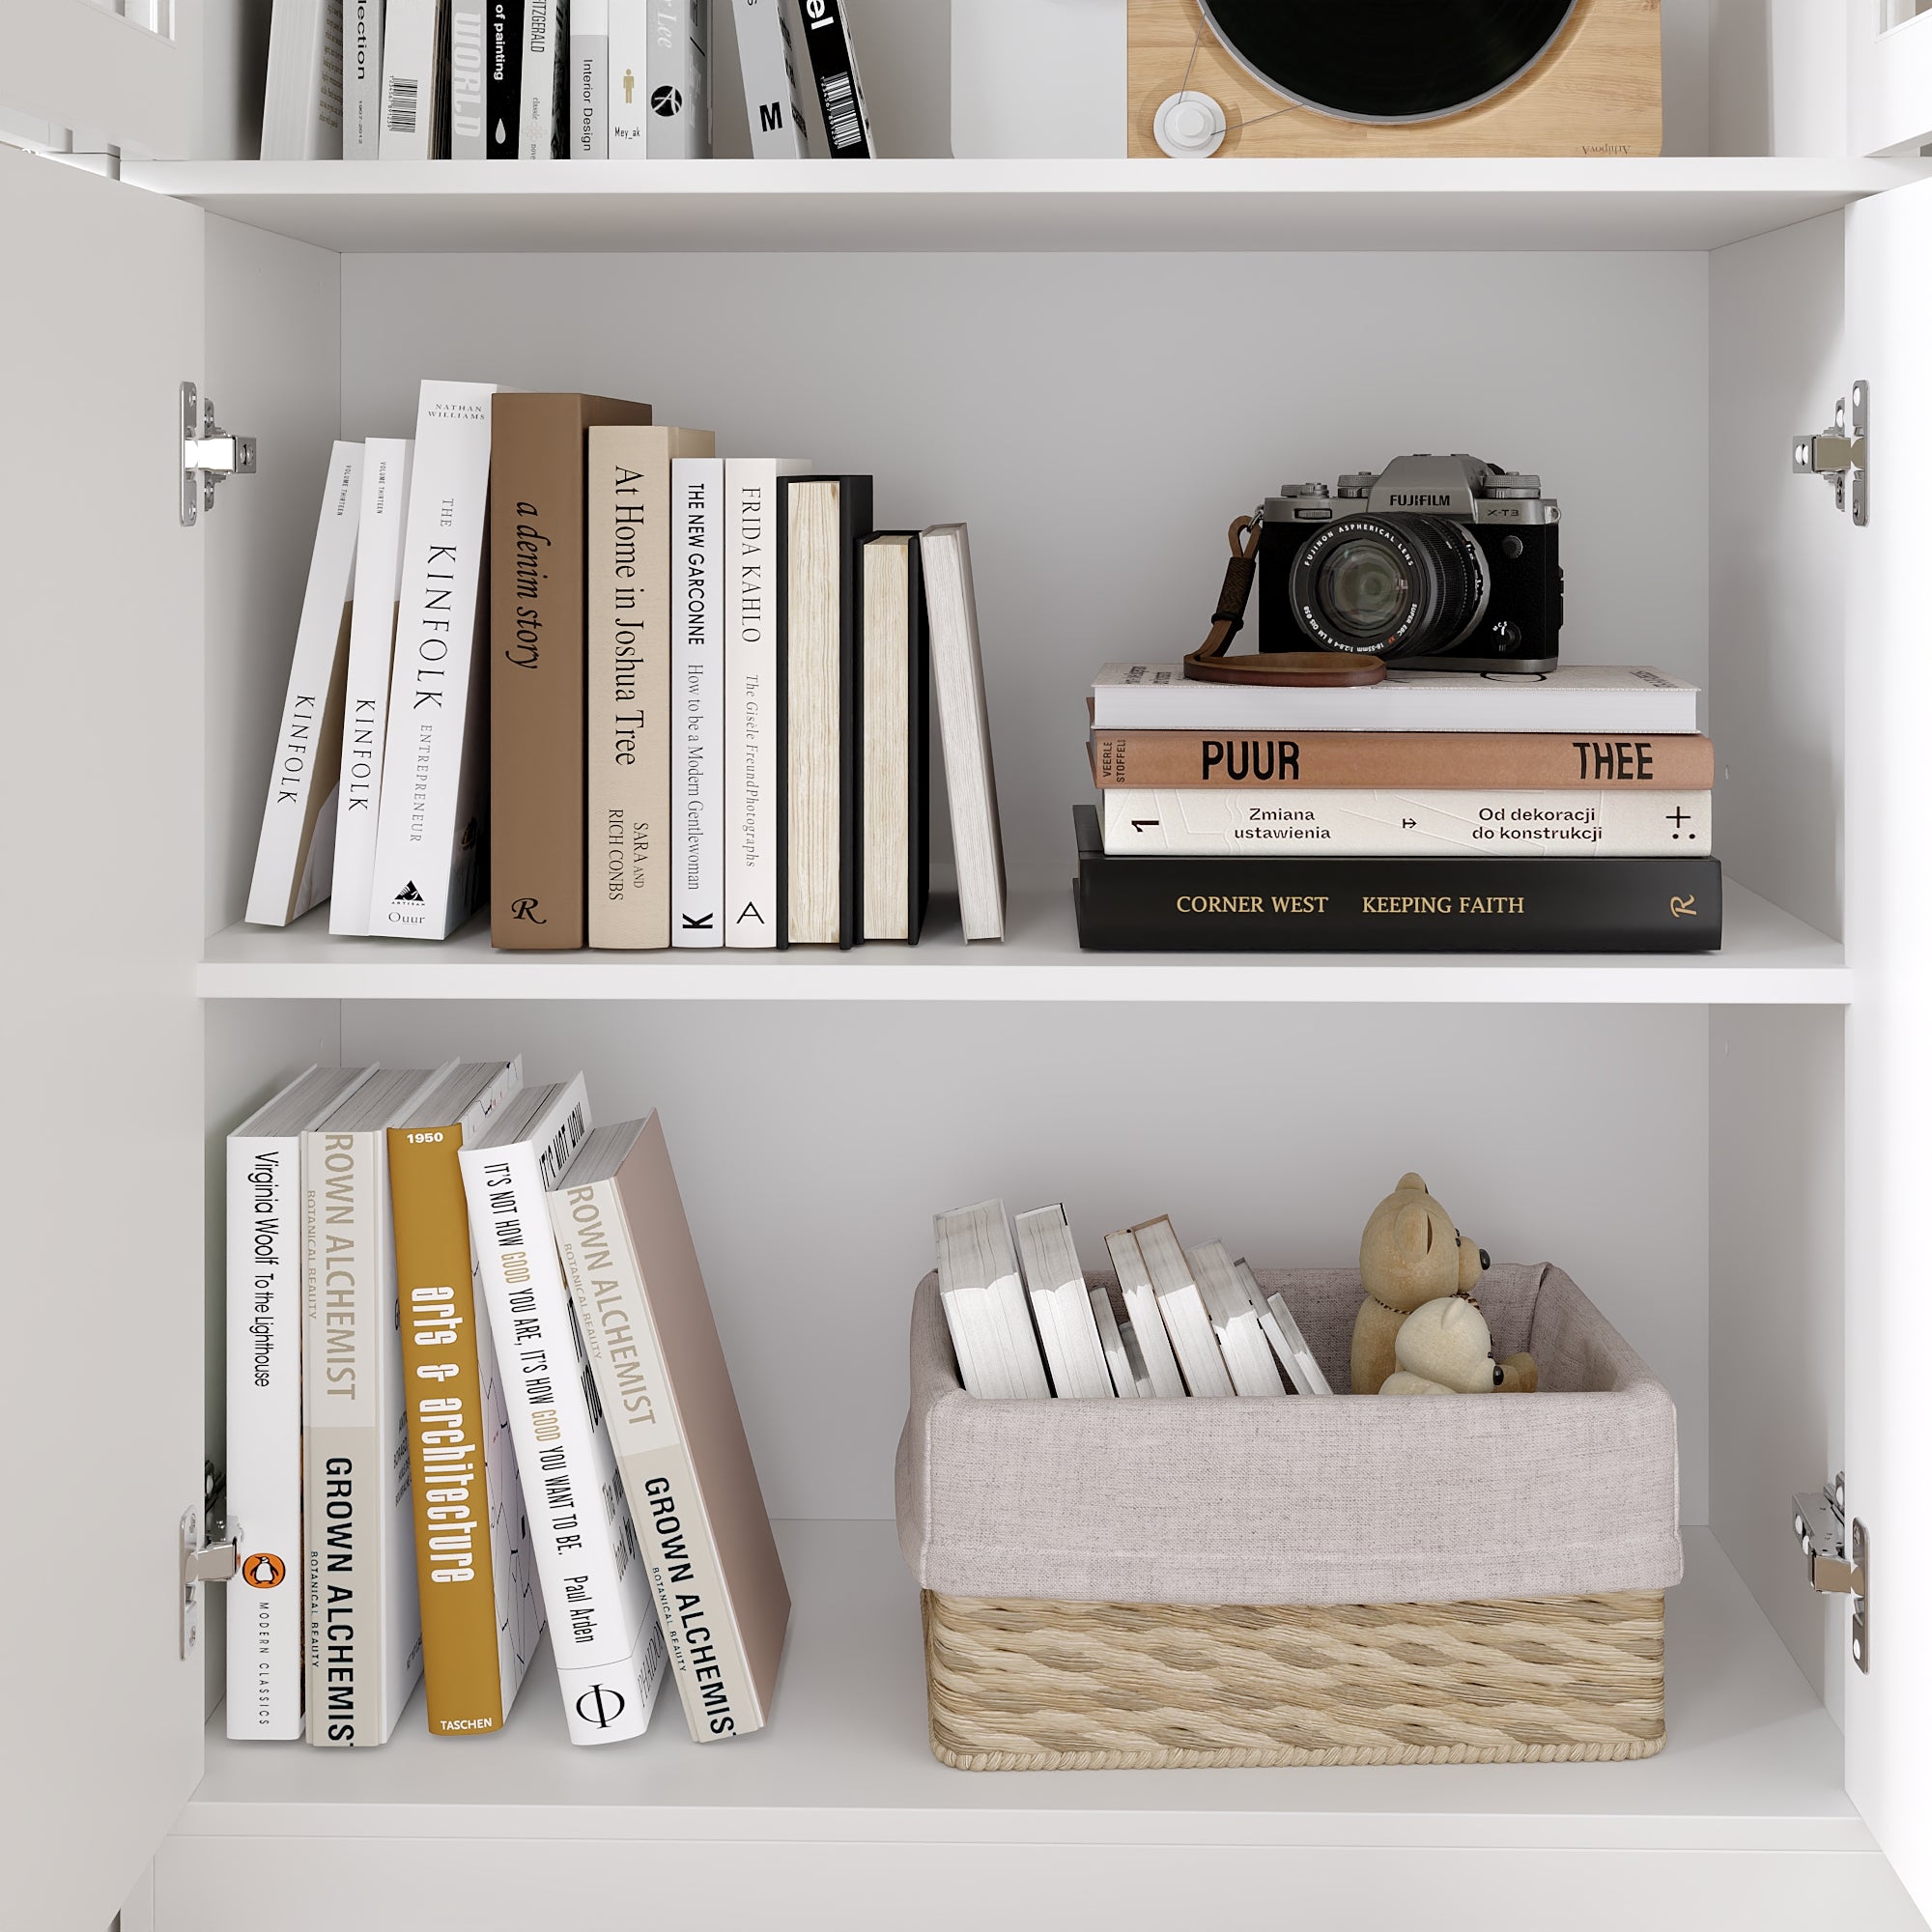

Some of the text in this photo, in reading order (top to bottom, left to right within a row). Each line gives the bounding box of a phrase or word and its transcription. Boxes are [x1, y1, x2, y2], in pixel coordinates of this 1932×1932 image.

[494, 4, 505, 81] of painting
[454, 13, 481, 137] WORLD
[582, 59, 593, 152] Interior Design
[759, 101, 782, 132] M
[428, 411, 485, 420] WILLIAMS
[336, 465, 352, 516] VOLUME THIRTEEN
[376, 486, 384, 514] THIRTEEN
[688, 483, 705, 509] THE
[1389, 495, 1451, 506] FUJIFILM
[688, 514, 705, 548] NEW
[742, 487, 761, 556] FRIDA
[1304, 524, 1414, 567] FUJINON ASPHERICAL LENS
[506, 501, 552, 669] a denim story
[688, 553, 705, 645] GARCONNE
[742, 565, 761, 642] KAHLO
[615, 466, 644, 766] At Home in Joshua Tree
[410, 497, 457, 843] THE KINFOLK ENTREPRENEUR
[688, 665, 703, 696] How
[747, 674, 759, 696] The
[688, 699, 699, 712] to
[688, 716, 703, 730] be
[746, 701, 758, 740] Gisèle
[277, 695, 316, 805] KINFOLK
[348, 698, 376, 811] KINFOLK
[688, 747, 703, 796] Modern
[1202, 740, 1654, 781] PUUR THEE
[1234, 826, 1331, 839] ustawienia
[1249, 808, 1316, 822] Zmiana
[1472, 826, 1603, 842] do konstrukcji
[1478, 808, 1596, 825] Od dekoracji
[609, 809, 624, 901] RICH CONBS
[634, 822, 649, 889] SARA AND
[688, 800, 704, 890] Gentlewoman
[511, 897, 548, 924] R
[682, 912, 714, 929] K
[736, 901, 765, 924] A
[1176, 895, 1525, 914] CORNER WEST KEEPING FAITH
[1670, 894, 1697, 919] R
[406, 1132, 444, 1144] 1950
[247, 1151, 279, 1387] Virginia Woolf To the Lighthouse
[325, 1134, 355, 1401] ROWN ALCHEMIST
[411, 1286, 464, 1346] arts
[567, 1184, 612, 1271] ROWN
[591, 1279, 656, 1425] ALCHEMIST
[484, 1162, 599, 1644] IT'S NOT HOW GOOD YOU ARE, IT'S HOW GOOD YOU WANT TO BE. Paul Arden
[419, 1398, 478, 1584] architecture
[326, 1457, 355, 1747] GROWN ALCHEMIS
[644, 1476, 738, 1737] GROWN ALCHEMIS
[652, 1567, 687, 1673] BOTANICAL BEAUTY
[259, 1602, 270, 1725] MODERN CLASSICS
[440, 1718, 493, 1731] TASCHEN
